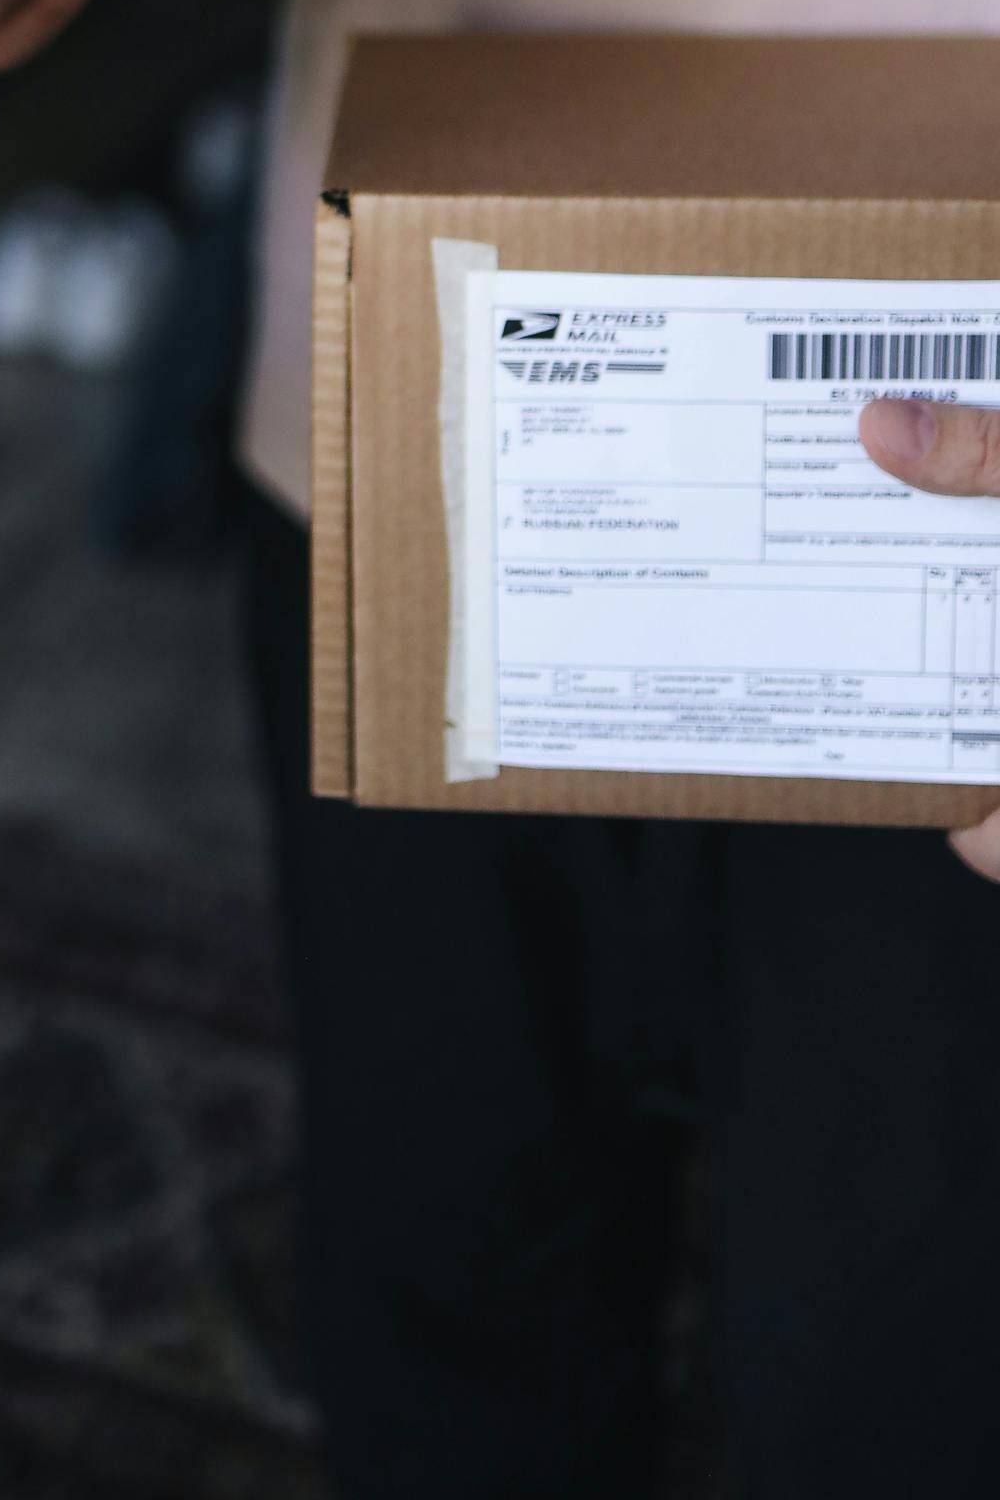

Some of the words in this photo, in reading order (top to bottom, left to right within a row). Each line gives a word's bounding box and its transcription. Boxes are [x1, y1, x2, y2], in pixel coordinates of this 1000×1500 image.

[571, 313, 668, 328] EXPRESS
[745, 312, 805, 324] Customs
[809, 312, 884, 324] Declaration
[567, 330, 619, 343] MAIL
[528, 359, 601, 384] EMS
[522, 517, 584, 530] RUSSIAN
[589, 517, 680, 530] FEDERATION
[559, 567, 630, 580] Description
[636, 567, 649, 578] of
[653, 568, 709, 579] Contents
